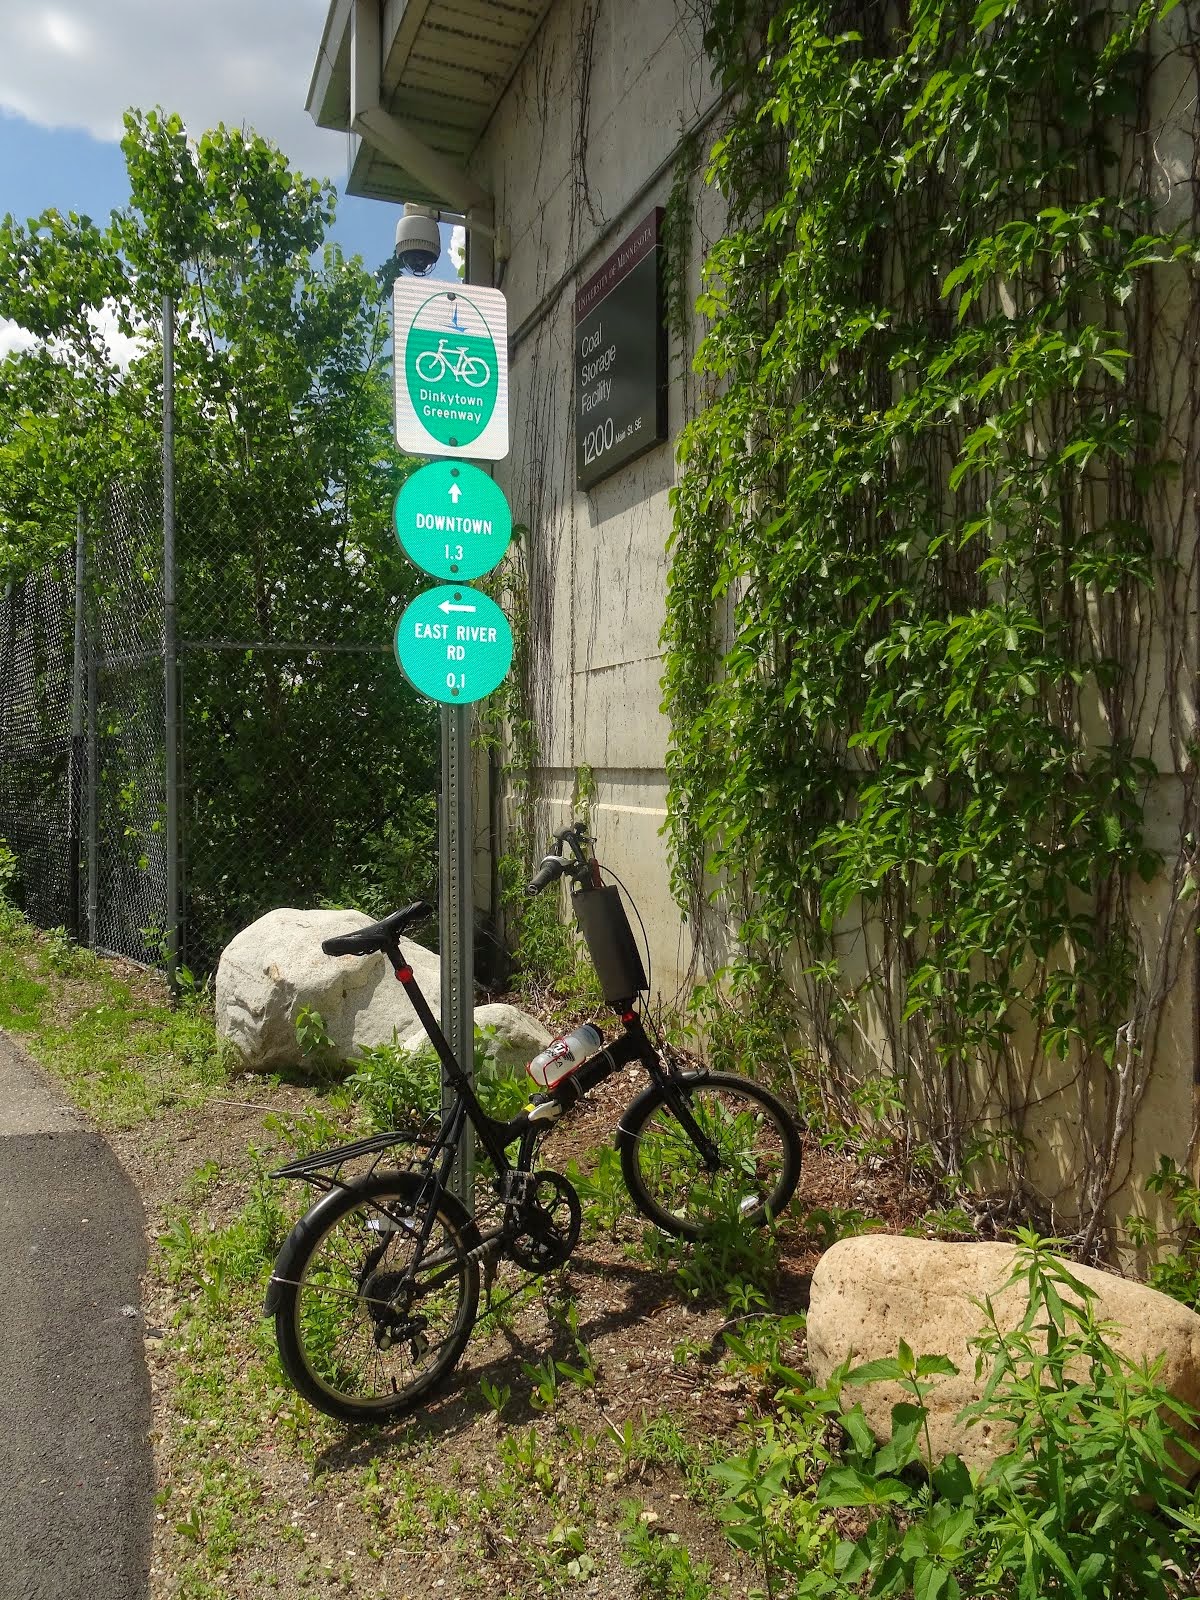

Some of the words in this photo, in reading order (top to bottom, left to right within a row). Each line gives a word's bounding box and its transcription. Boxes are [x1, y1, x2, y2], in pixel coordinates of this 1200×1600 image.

[578, 275, 608, 312] UNIVERSITY
[617, 227, 652, 270] MINNESOTA
[581, 322, 602, 358] Coal
[581, 344, 616, 387] Storage
[420, 388, 483, 407] Dinkytown
[581, 378, 612, 416] Facility
[423, 405, 482, 424] Greenway
[582, 417, 614, 467] 1200
[615, 430, 626, 444] Main
[634, 416, 642, 431] SE
[416, 513, 493, 535] DOWNTOWN
[444, 544, 464, 560] 1.3
[414, 622, 449, 640] EAST
[456, 625, 497, 643] RIVER
[446, 645, 465, 661] RD
[446, 673, 466, 689] 0.1
